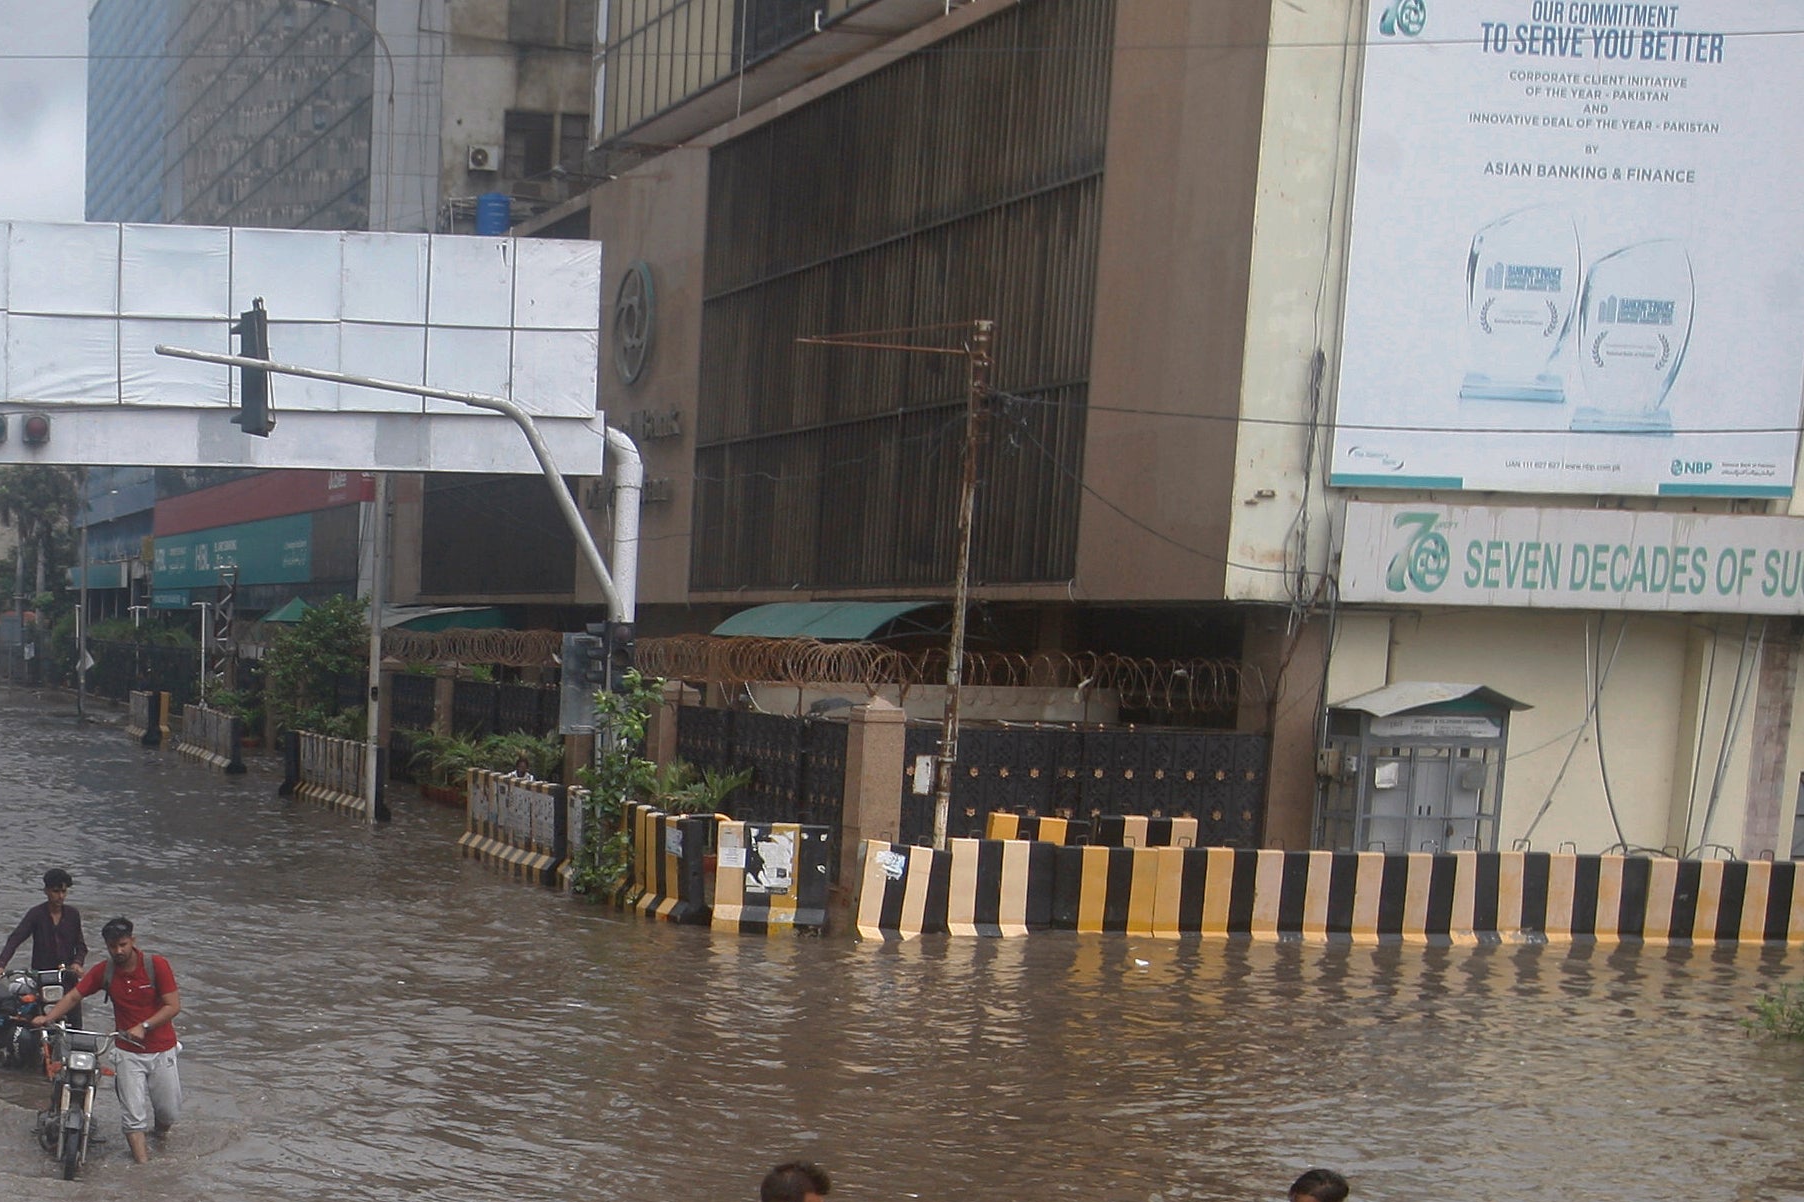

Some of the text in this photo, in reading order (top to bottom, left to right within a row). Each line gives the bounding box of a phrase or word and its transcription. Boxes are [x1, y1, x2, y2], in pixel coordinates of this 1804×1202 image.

[1531, 0, 1679, 29] OUR COMMITMENT
[1480, 22, 1725, 64] TO SERVE YOU BETTER
[1508, 70, 1688, 88] CORPORATE CLIENT INITIATIVE
[1525, 86, 1542, 97] OF
[1545, 87, 1568, 98] THE
[1570, 88, 1602, 100] YEAR
[1612, 90, 1669, 102] PAKISTAN
[1582, 103, 1608, 115] AND
[1468, 112, 1539, 126] INNOVATIVE
[1542, 116, 1573, 129] DEAL
[1576, 117, 1592, 129] OF
[1595, 118, 1619, 130] THE
[1621, 119, 1653, 132] YEAR
[1662, 121, 1719, 134] PAKISTAN
[1584, 144, 1599, 155] BY
[1483, 161, 1696, 184] ASIAN BANKING & FINANCE
[1684, 461, 1712, 474] NBP
[1463, 538, 1804, 598] SEVEN DECADES OF SU
